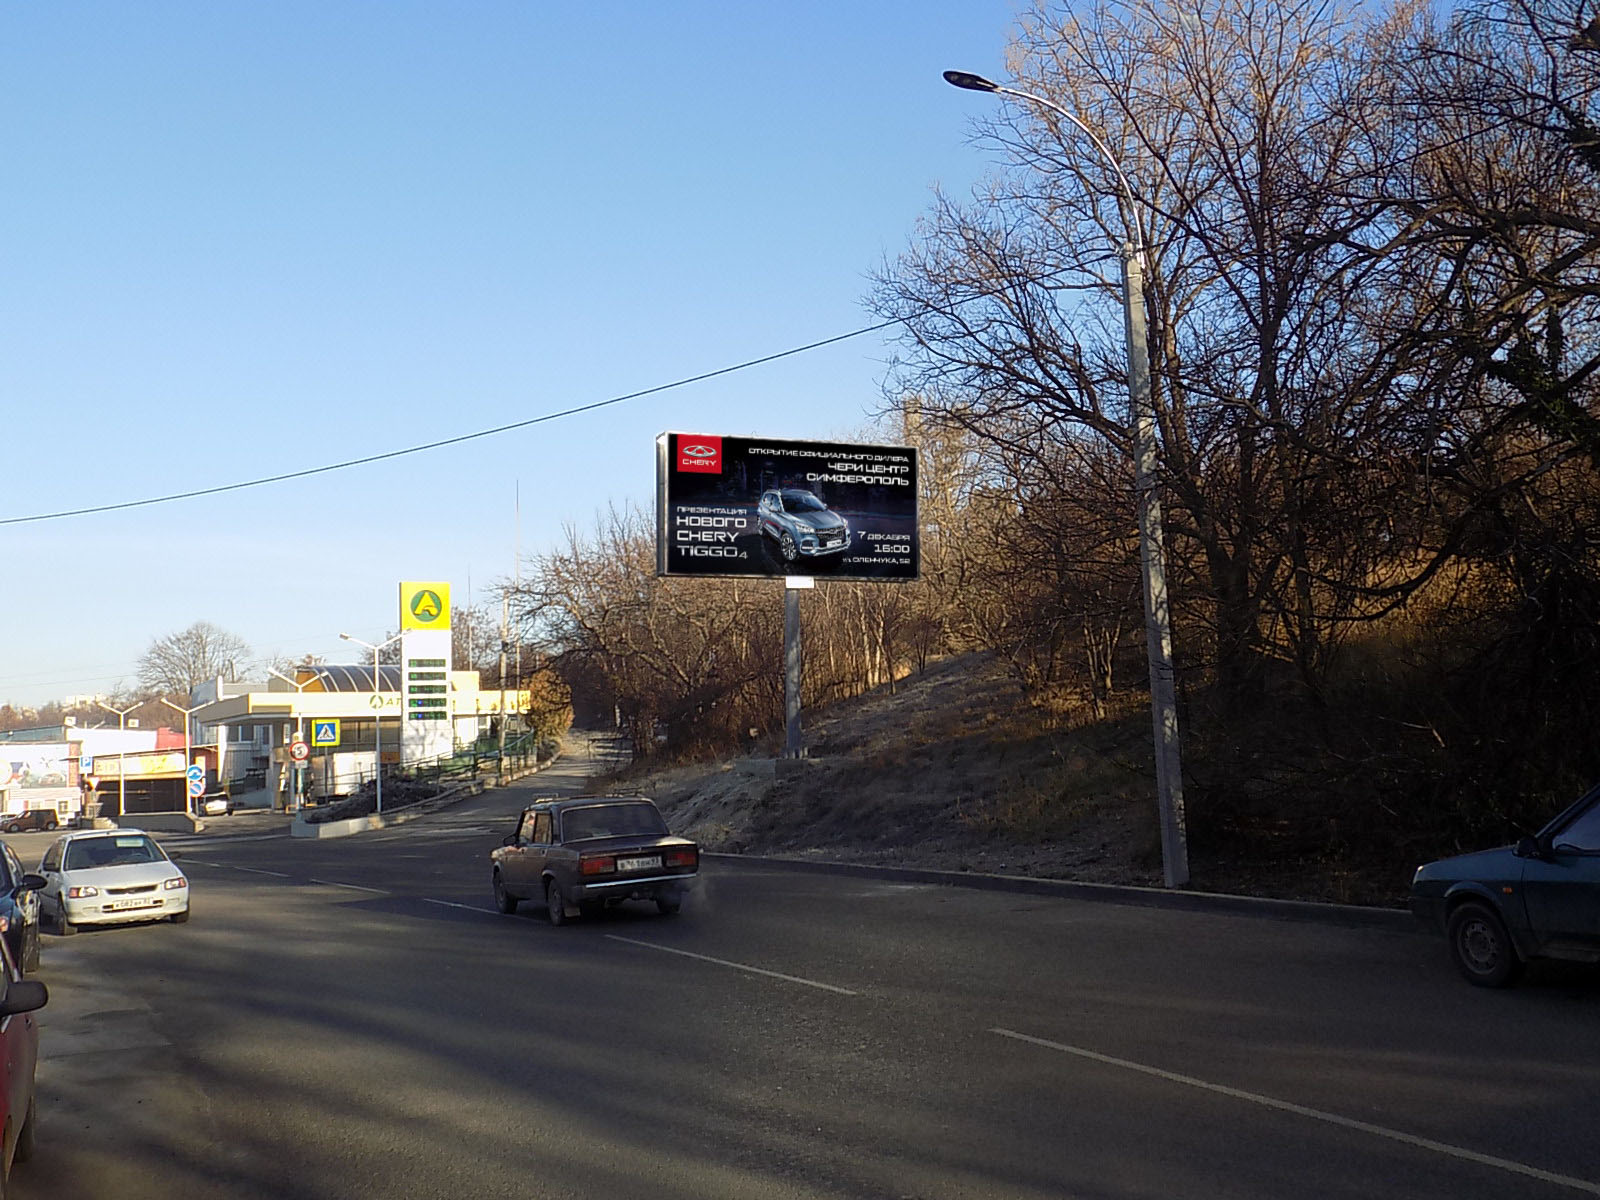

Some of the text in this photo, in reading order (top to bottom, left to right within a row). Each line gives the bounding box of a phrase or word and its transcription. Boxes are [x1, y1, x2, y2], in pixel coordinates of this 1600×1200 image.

[748, 448, 909, 463] ОТКРЫТИЕ ОФИЦИАЛЬНОГО ДИЛЕРА
[682, 458, 717, 467] CHERY
[827, 462, 909, 474] ЧЕРИ ЦЕНТР
[806, 472, 909, 486] СИМФЕРОПОЛЬ
[676, 506, 747, 515] ПРЕЗЕНТАЦИЯ
[676, 516, 747, 528] НОВОГО
[676, 530, 739, 542] CHERY
[857, 531, 911, 541] 7 ДЕКАБРЯ
[874, 544, 910, 553] 16:00
